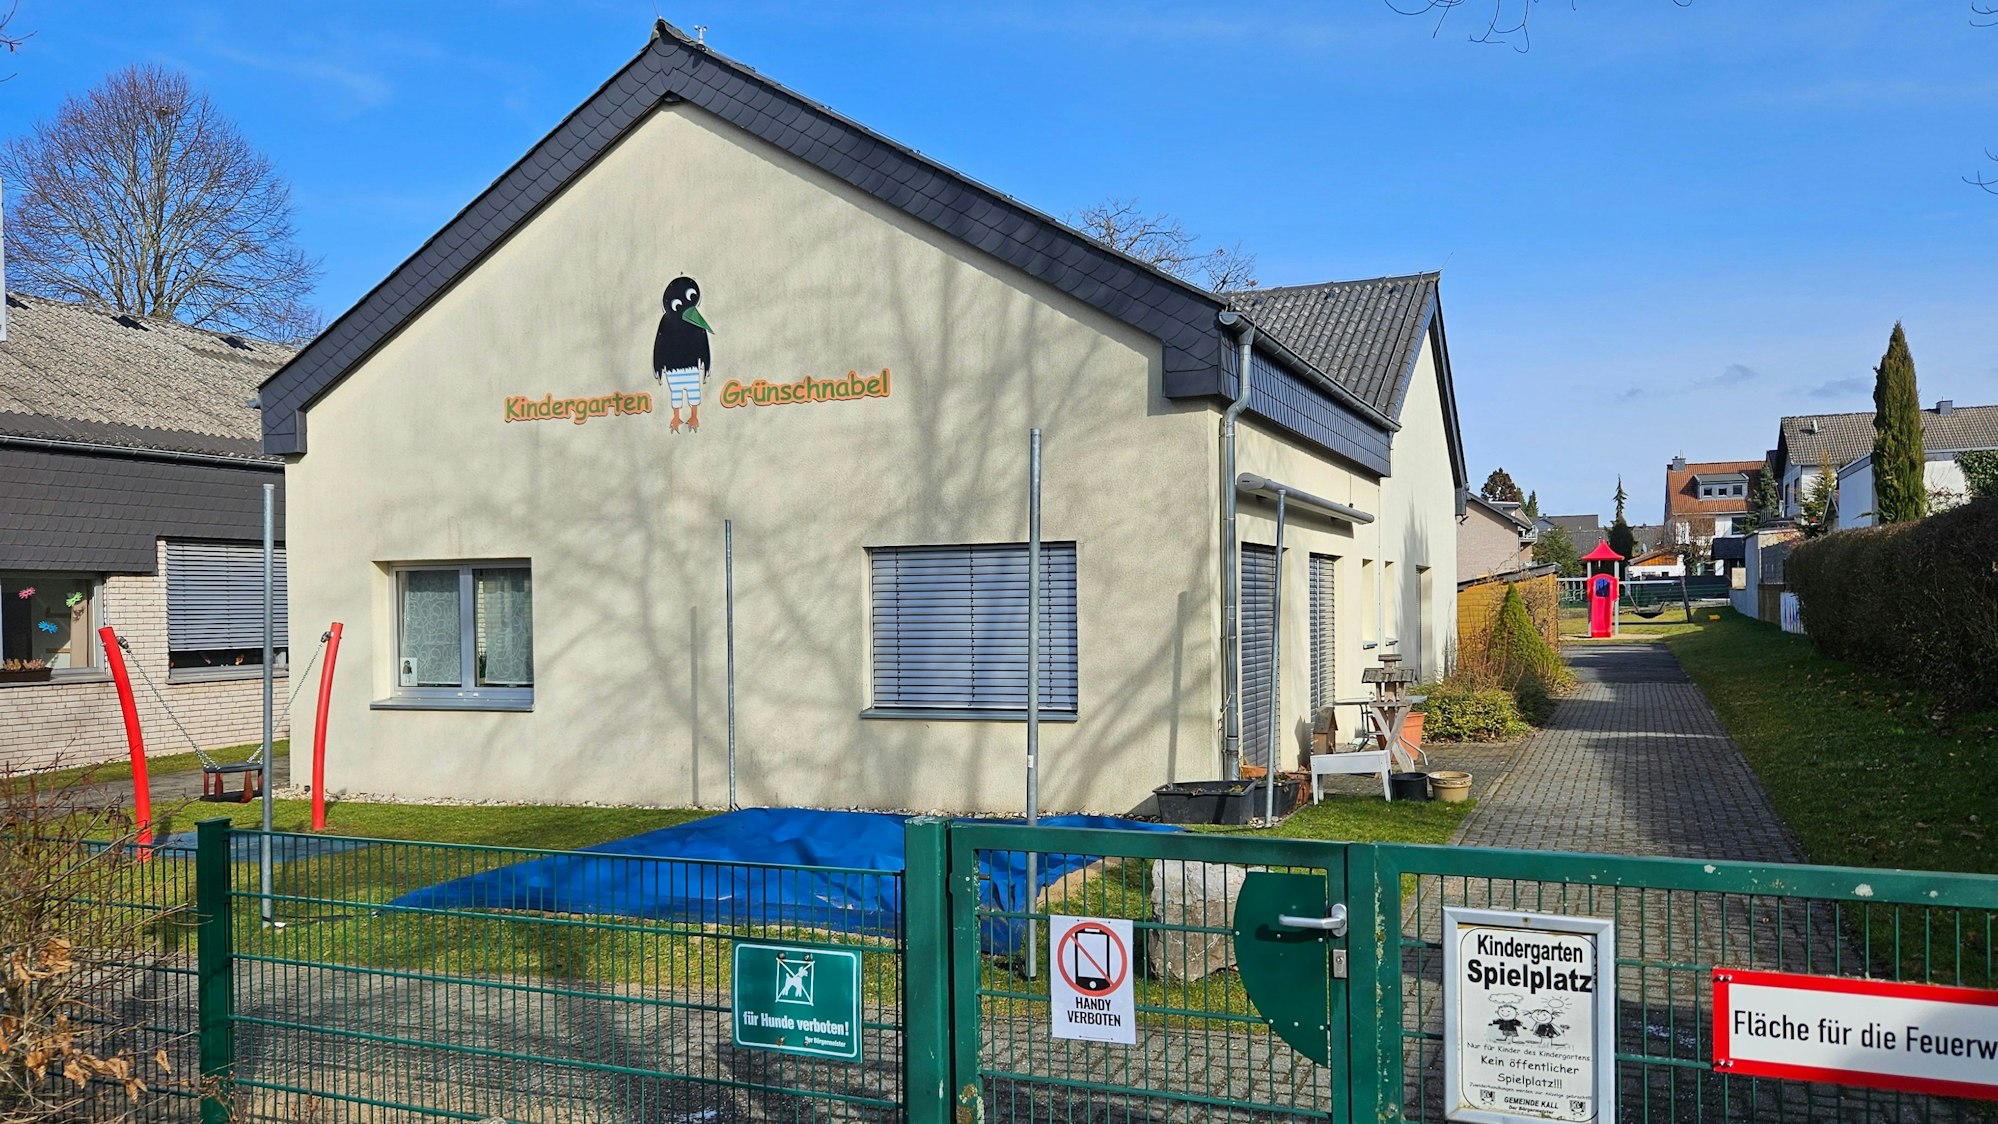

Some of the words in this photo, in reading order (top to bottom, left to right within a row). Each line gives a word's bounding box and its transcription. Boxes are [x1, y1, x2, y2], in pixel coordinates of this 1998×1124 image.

[505, 393, 651, 423] Kindergarten
[720, 368, 891, 408] Grünschnabel
[1477, 934, 1583, 965] Kindergarten
[1467, 958, 1593, 995] Spielplatz
[1075, 996, 1112, 1012] HANDY
[743, 1011, 758, 1026] für
[761, 1012, 795, 1030] Hunde
[796, 1018, 850, 1036] verboten!
[1067, 1010, 1121, 1027] VERBOTEN
[1733, 1009, 1810, 1041] Fläche
[1817, 1017, 1852, 1046] für
[1861, 1022, 1897, 1050] die
[1906, 1026, 1998, 1060] Feuerw
[1467, 1041, 1481, 1049] Nur
[1484, 1043, 1495, 1051] für
[1497, 1045, 1521, 1054] Kinder
[1523, 1048, 1536, 1056] des
[1480, 1055, 1505, 1067] Kein
[1509, 1059, 1580, 1075] öffentlicher
[1497, 1072, 1563, 1089] Spielplatz!!!
[1503, 1096, 1539, 1107] GEMEINDE
[1541, 1100, 1559, 1109] KALL
